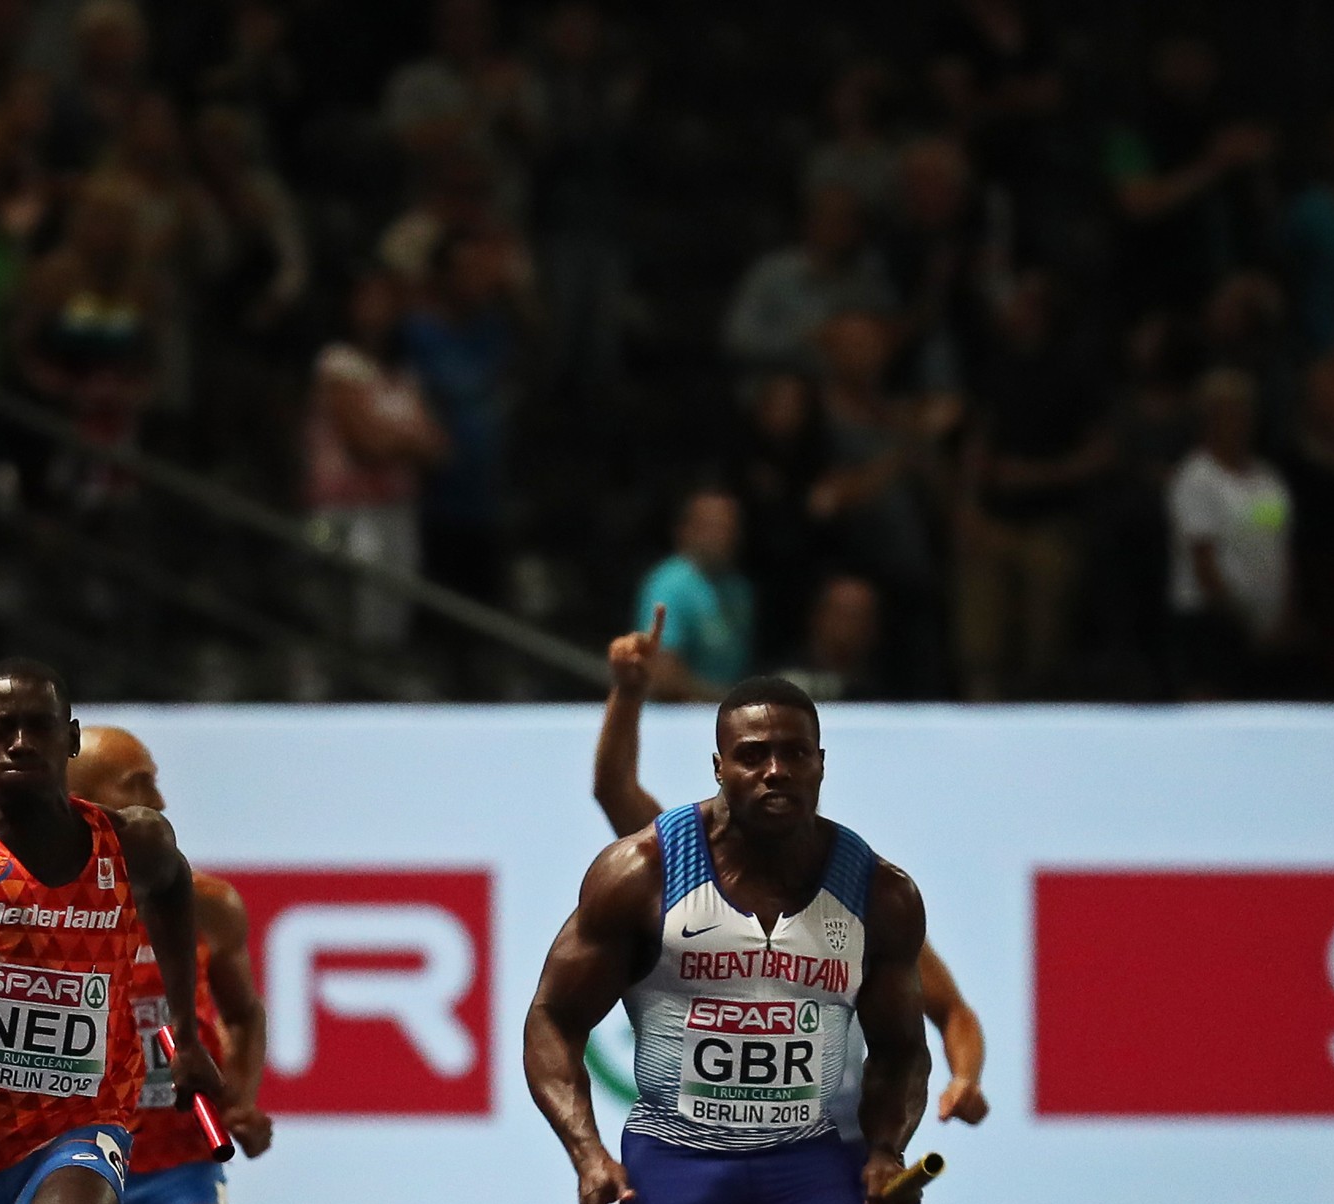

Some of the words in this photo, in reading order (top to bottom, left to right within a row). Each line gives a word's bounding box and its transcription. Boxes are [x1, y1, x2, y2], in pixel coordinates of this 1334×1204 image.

[680, 950, 759, 980] GREAT
[761, 950, 849, 993] BRITAIN
[691, 1003, 792, 1031] SPAR
[3, 1053, 30, 1065] RUN
[693, 1037, 814, 1085] GBR
[48, 1074, 92, 1093] 2018
[720, 1088, 746, 1099] RUN
[693, 1100, 763, 1123] BERLIN
[770, 1105, 809, 1123] 2018
